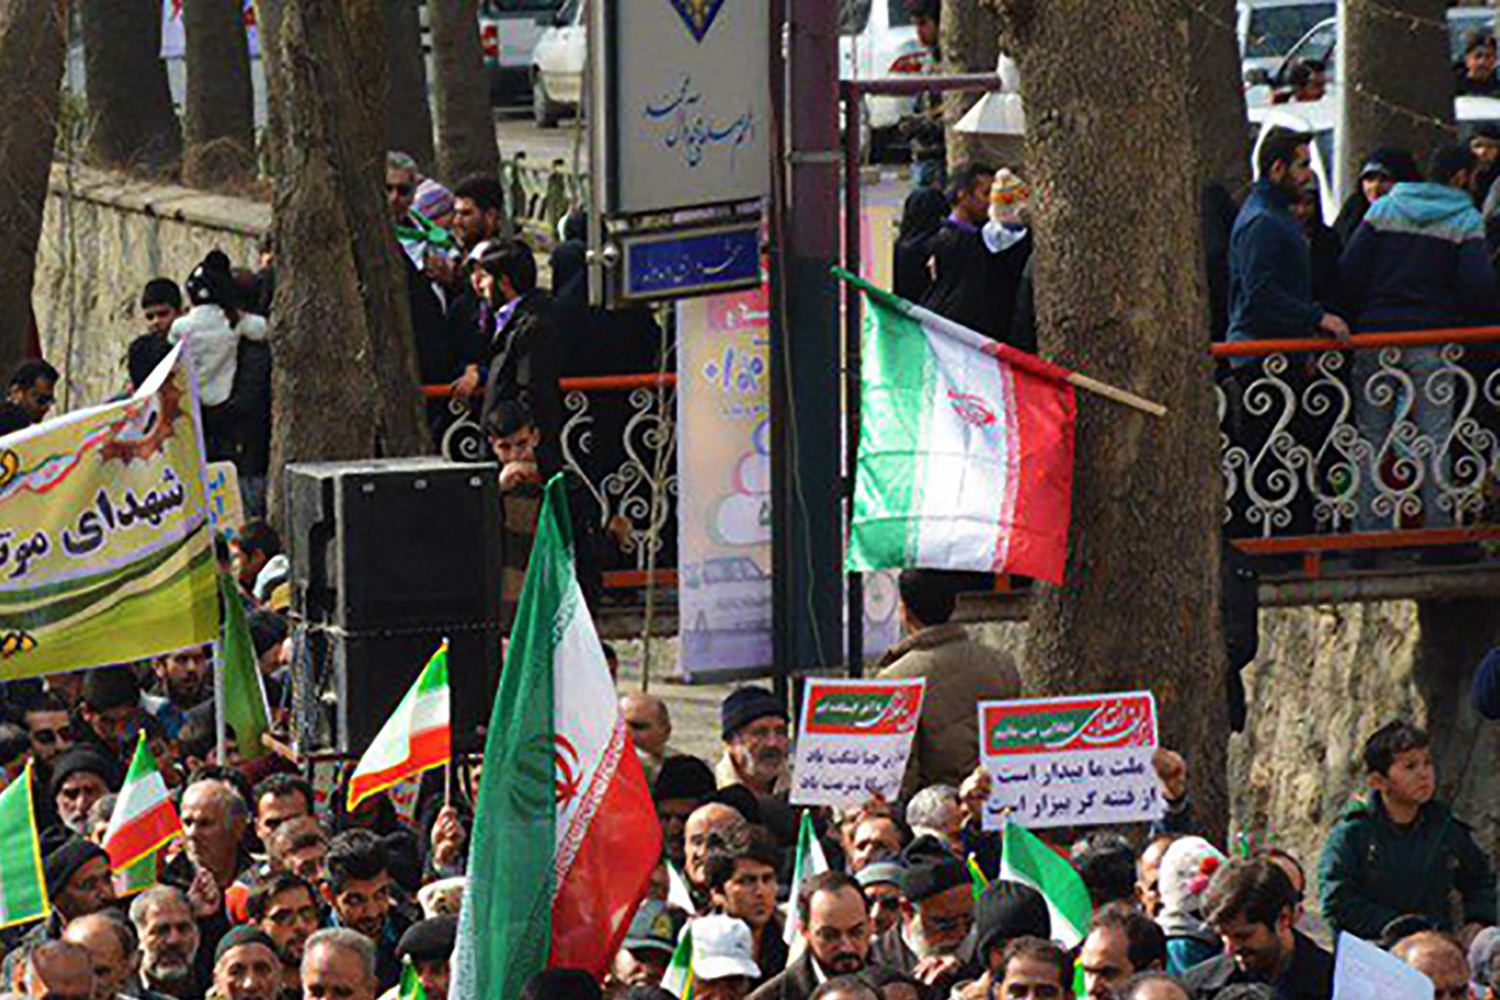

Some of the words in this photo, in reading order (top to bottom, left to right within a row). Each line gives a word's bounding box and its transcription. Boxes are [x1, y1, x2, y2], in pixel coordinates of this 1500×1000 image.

[62, 466, 185, 555] شهدای
[996, 763, 1037, 784] است
[1042, 762, 1084, 787] بیدار
[1088, 759, 1106, 777] ما
[1108, 757, 1146, 777] ملت
[987, 794, 1027, 815] است
[1032, 793, 1072, 819] بیزار
[1102, 789, 1136, 806] فتنه
[1141, 786, 1157, 812] از
